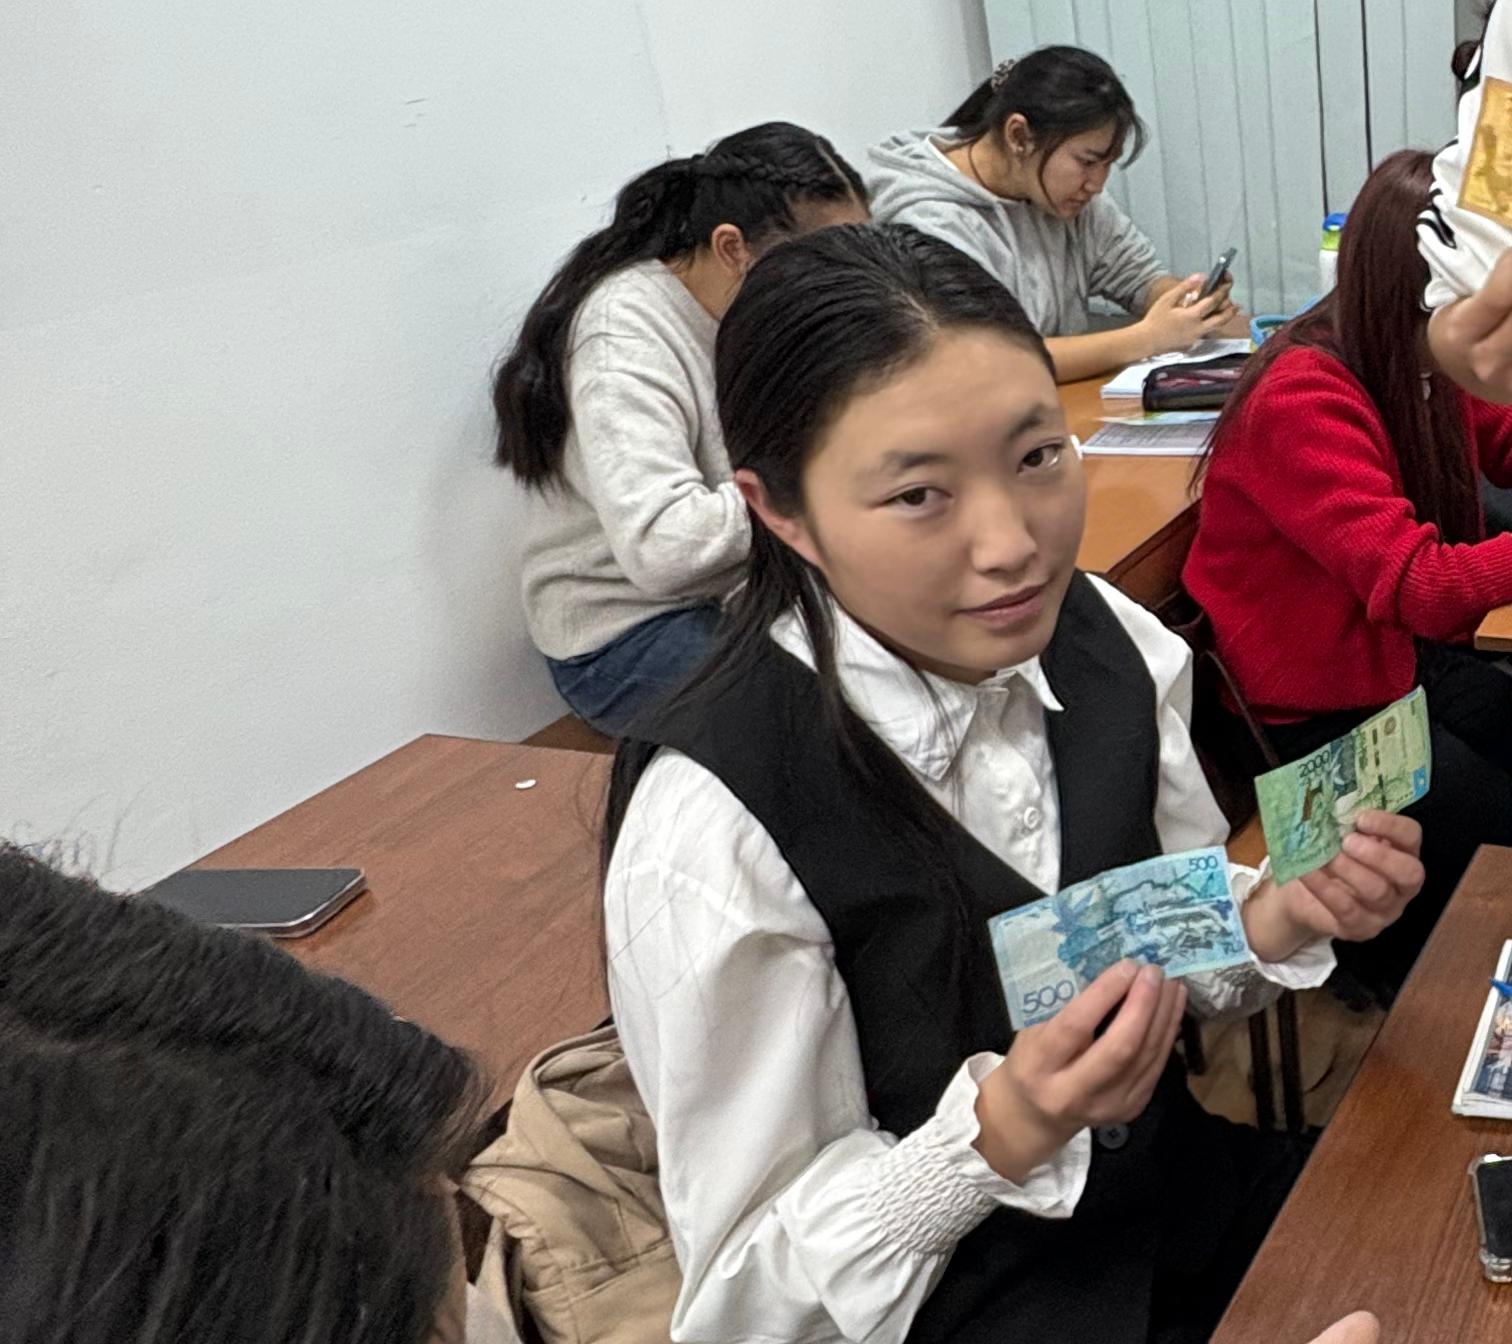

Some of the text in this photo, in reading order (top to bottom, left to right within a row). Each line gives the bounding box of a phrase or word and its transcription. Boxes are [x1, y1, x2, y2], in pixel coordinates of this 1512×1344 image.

[1298, 749, 1331, 778] 2000
[1188, 854, 1218, 873] 500
[1022, 979, 1075, 1014] 500
